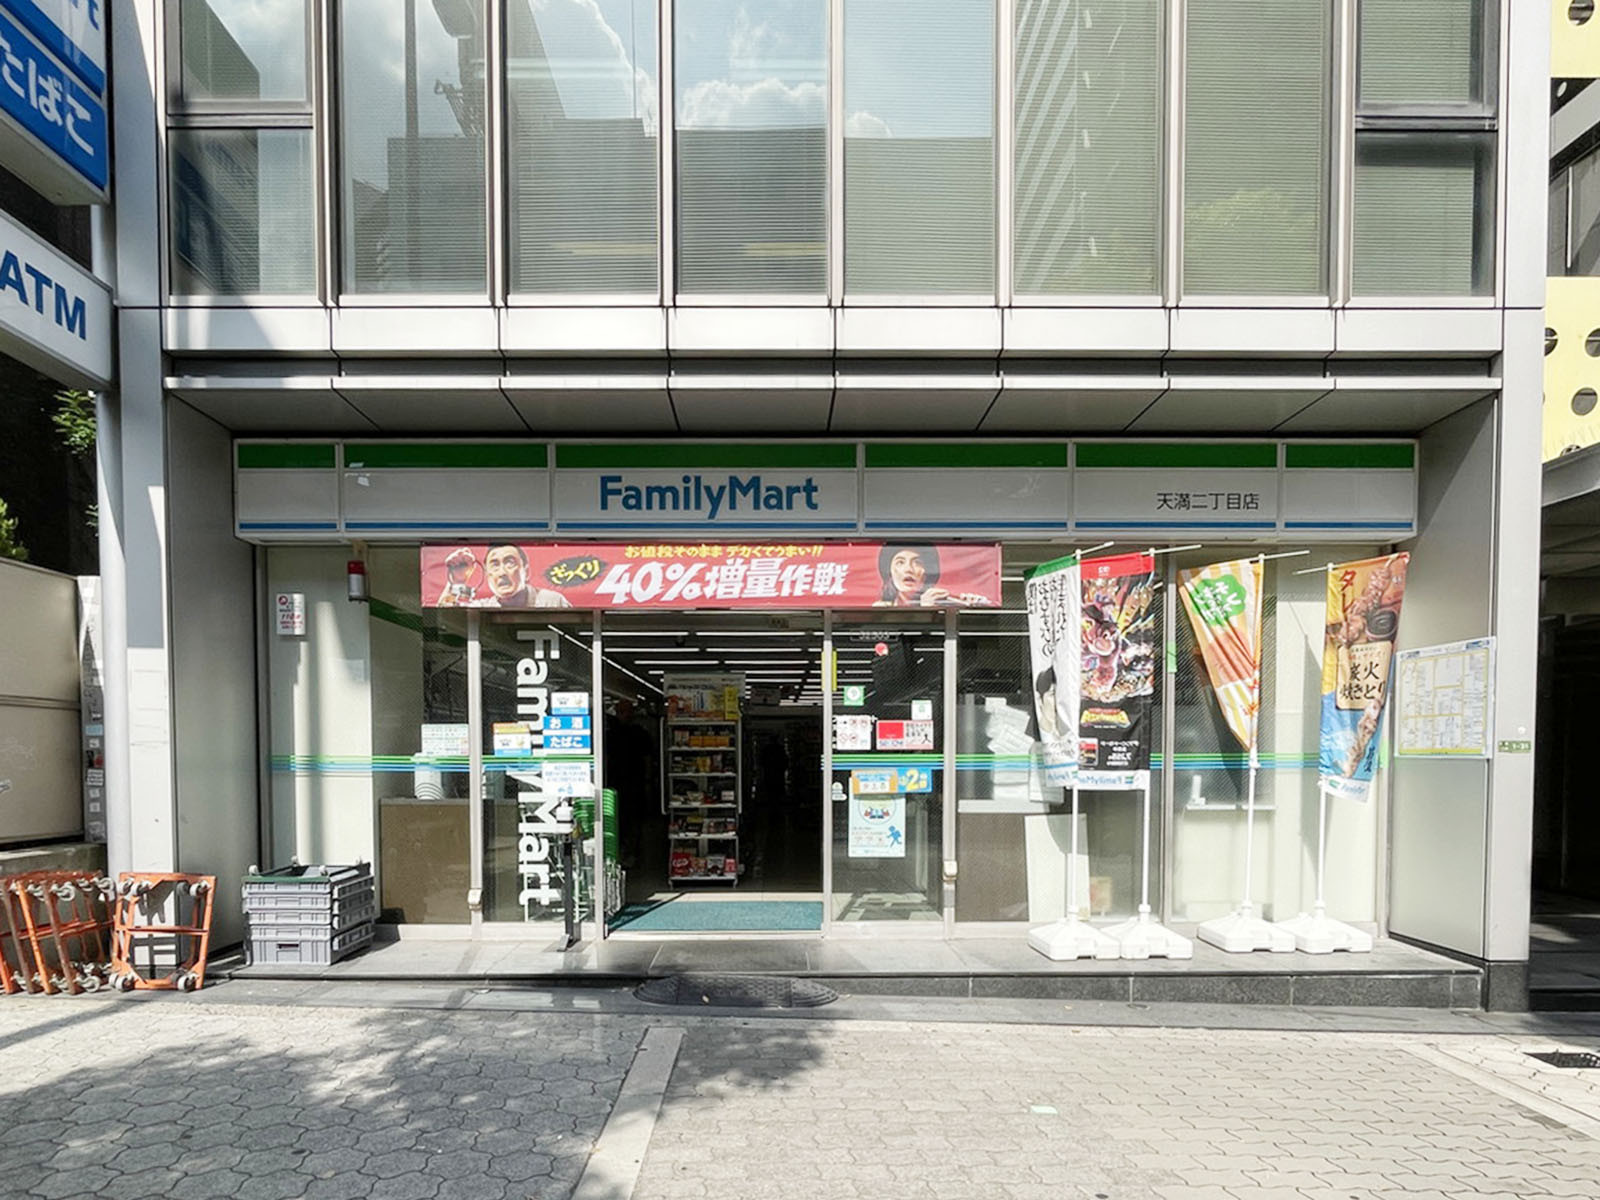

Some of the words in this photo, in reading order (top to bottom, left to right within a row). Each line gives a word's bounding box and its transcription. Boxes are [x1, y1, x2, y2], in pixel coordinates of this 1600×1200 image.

[0, 249, 86, 341] ATM
[600, 475, 818, 520] FamilyMart
[1156, 493, 1260, 510] 天満二丁目店
[594, 558, 849, 604] 40%増量作戦
[549, 736, 584, 750] たばこ
